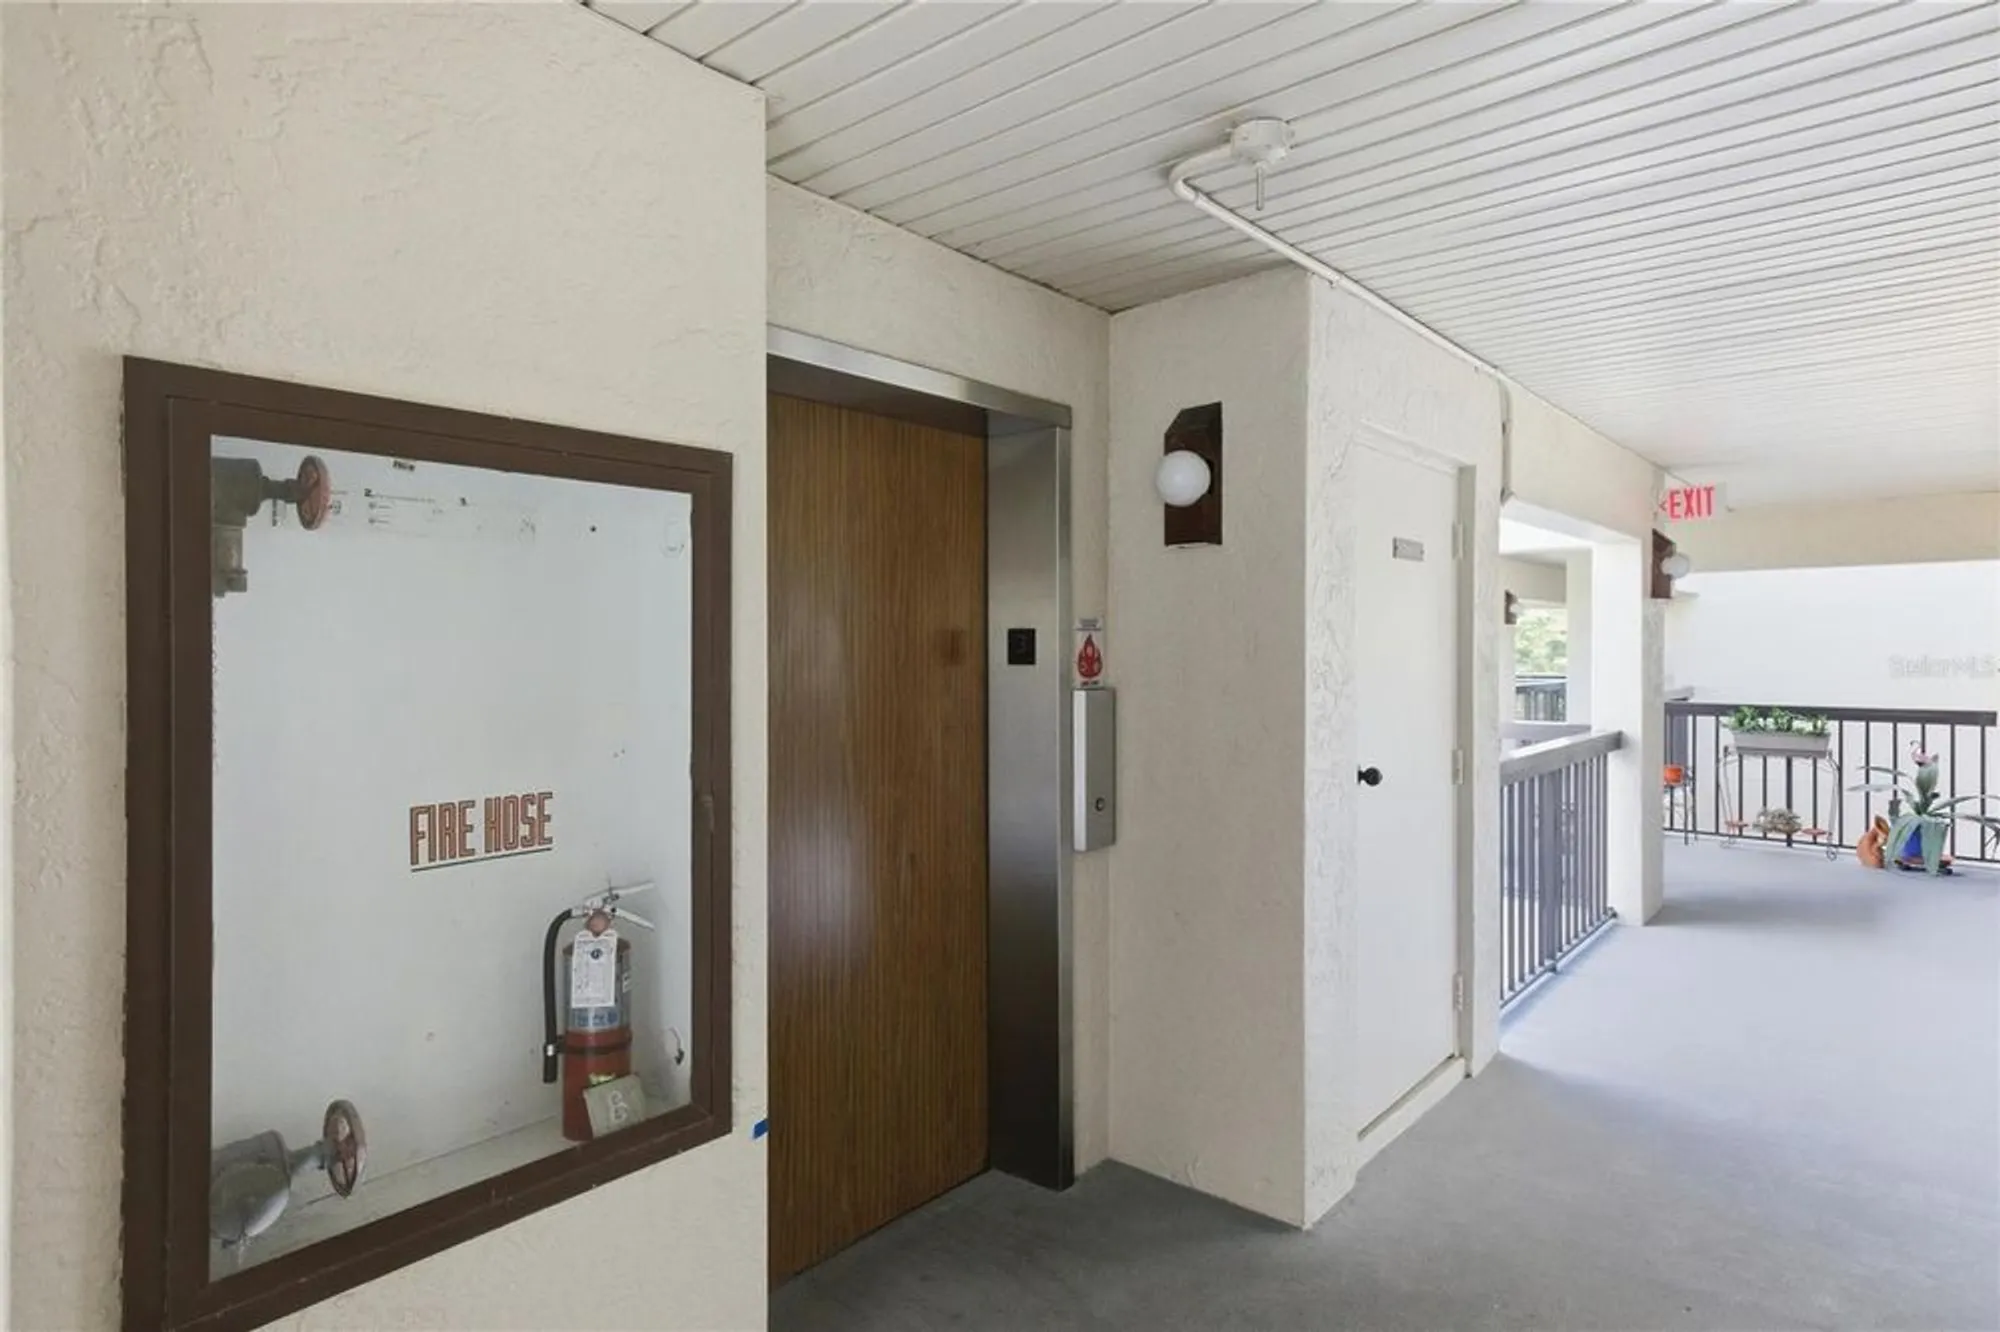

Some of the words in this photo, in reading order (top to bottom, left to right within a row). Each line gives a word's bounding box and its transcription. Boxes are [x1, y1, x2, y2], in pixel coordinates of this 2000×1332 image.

[1669, 486, 1715, 519] EXIT
[410, 800, 476, 866] FIRE
[484, 792, 553, 853] HOSE
